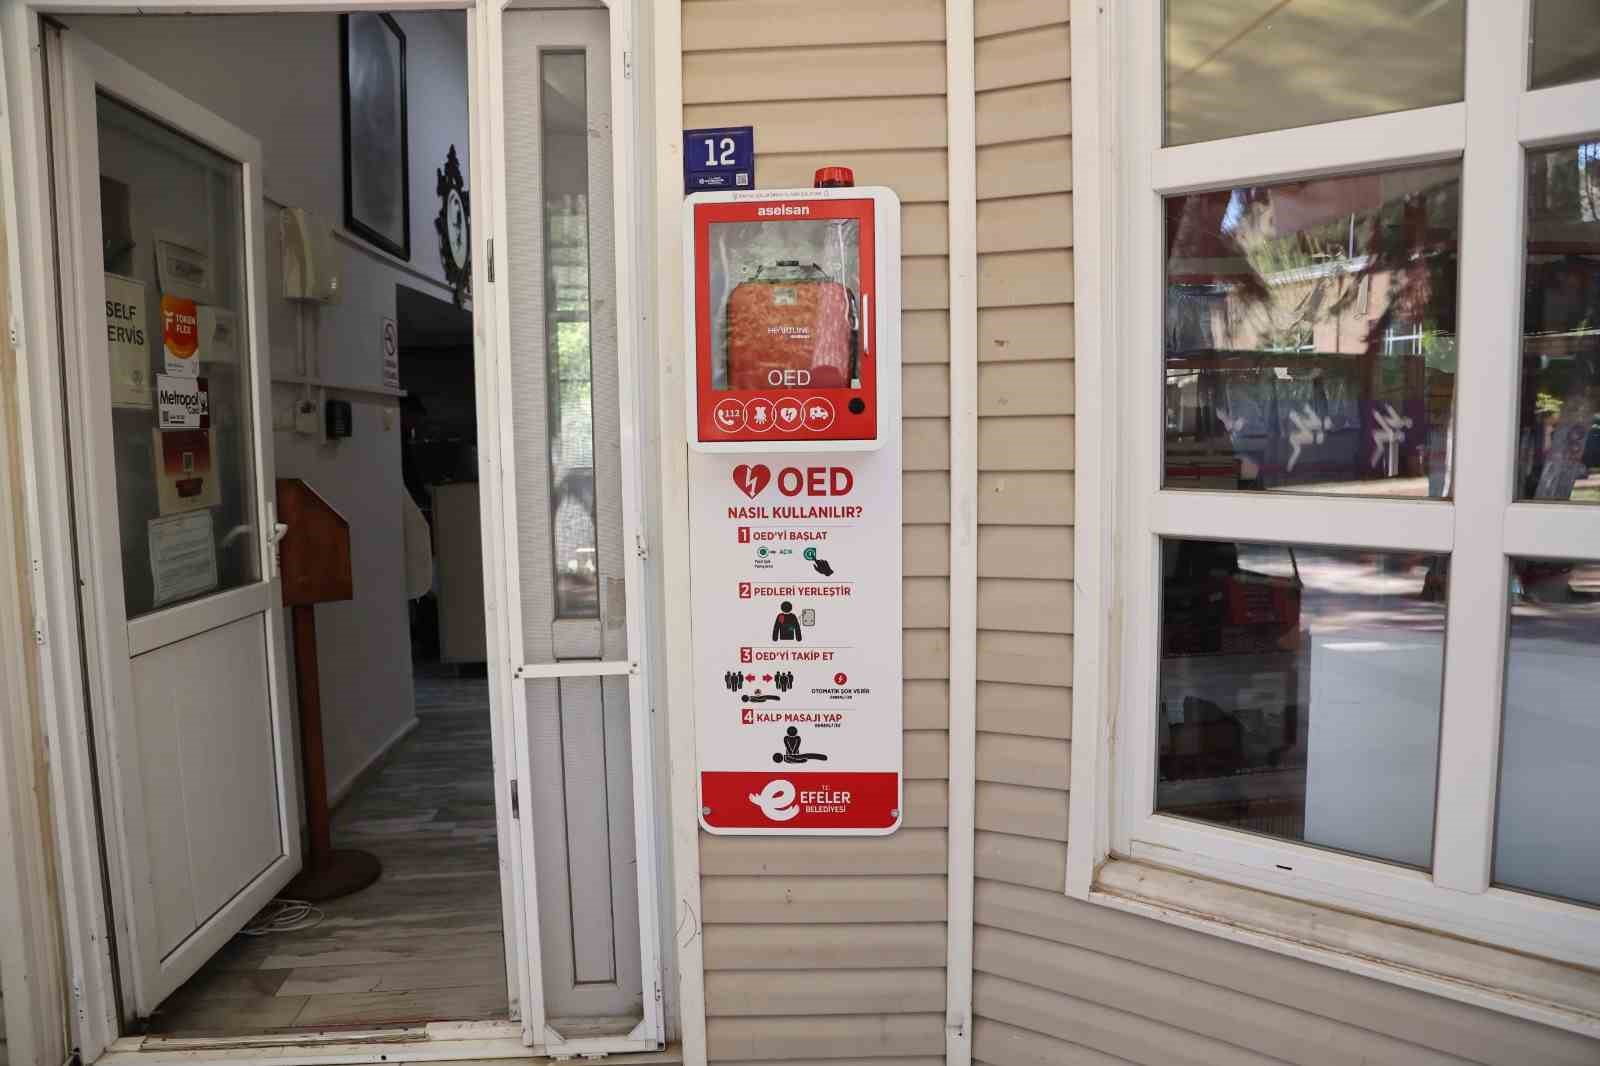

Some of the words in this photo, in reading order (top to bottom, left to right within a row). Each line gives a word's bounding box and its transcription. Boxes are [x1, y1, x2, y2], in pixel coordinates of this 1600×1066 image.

[705, 138, 735, 166] 12
[757, 205, 811, 217] aselsan
[106, 301, 136, 320] SELF
[107, 325, 145, 345] ERVİS
[767, 369, 811, 386] OED
[159, 389, 199, 408] Metropol
[724, 409, 740, 418] 112
[777, 466, 854, 497] OED
[728, 506, 769, 519] NASIL
[772, 505, 863, 519] KULLANILIR?
[789, 531, 828, 542] BAŞLAT
[741, 584, 750, 597] 2
[753, 585, 796, 597] PEDLERİ
[798, 585, 852, 597] YERLEŞTİR
[742, 648, 751, 662] 3
[792, 650, 820, 661] TAKİP
[822, 652, 835, 661] ET
[743, 710, 752, 724] 4
[757, 713, 782, 722] KALP
[784, 713, 821, 722] MASAJI
[822, 713, 842, 722] YAP
[799, 791, 851, 804] EFELER
[805, 804, 846, 813] BELEDİYESİ
